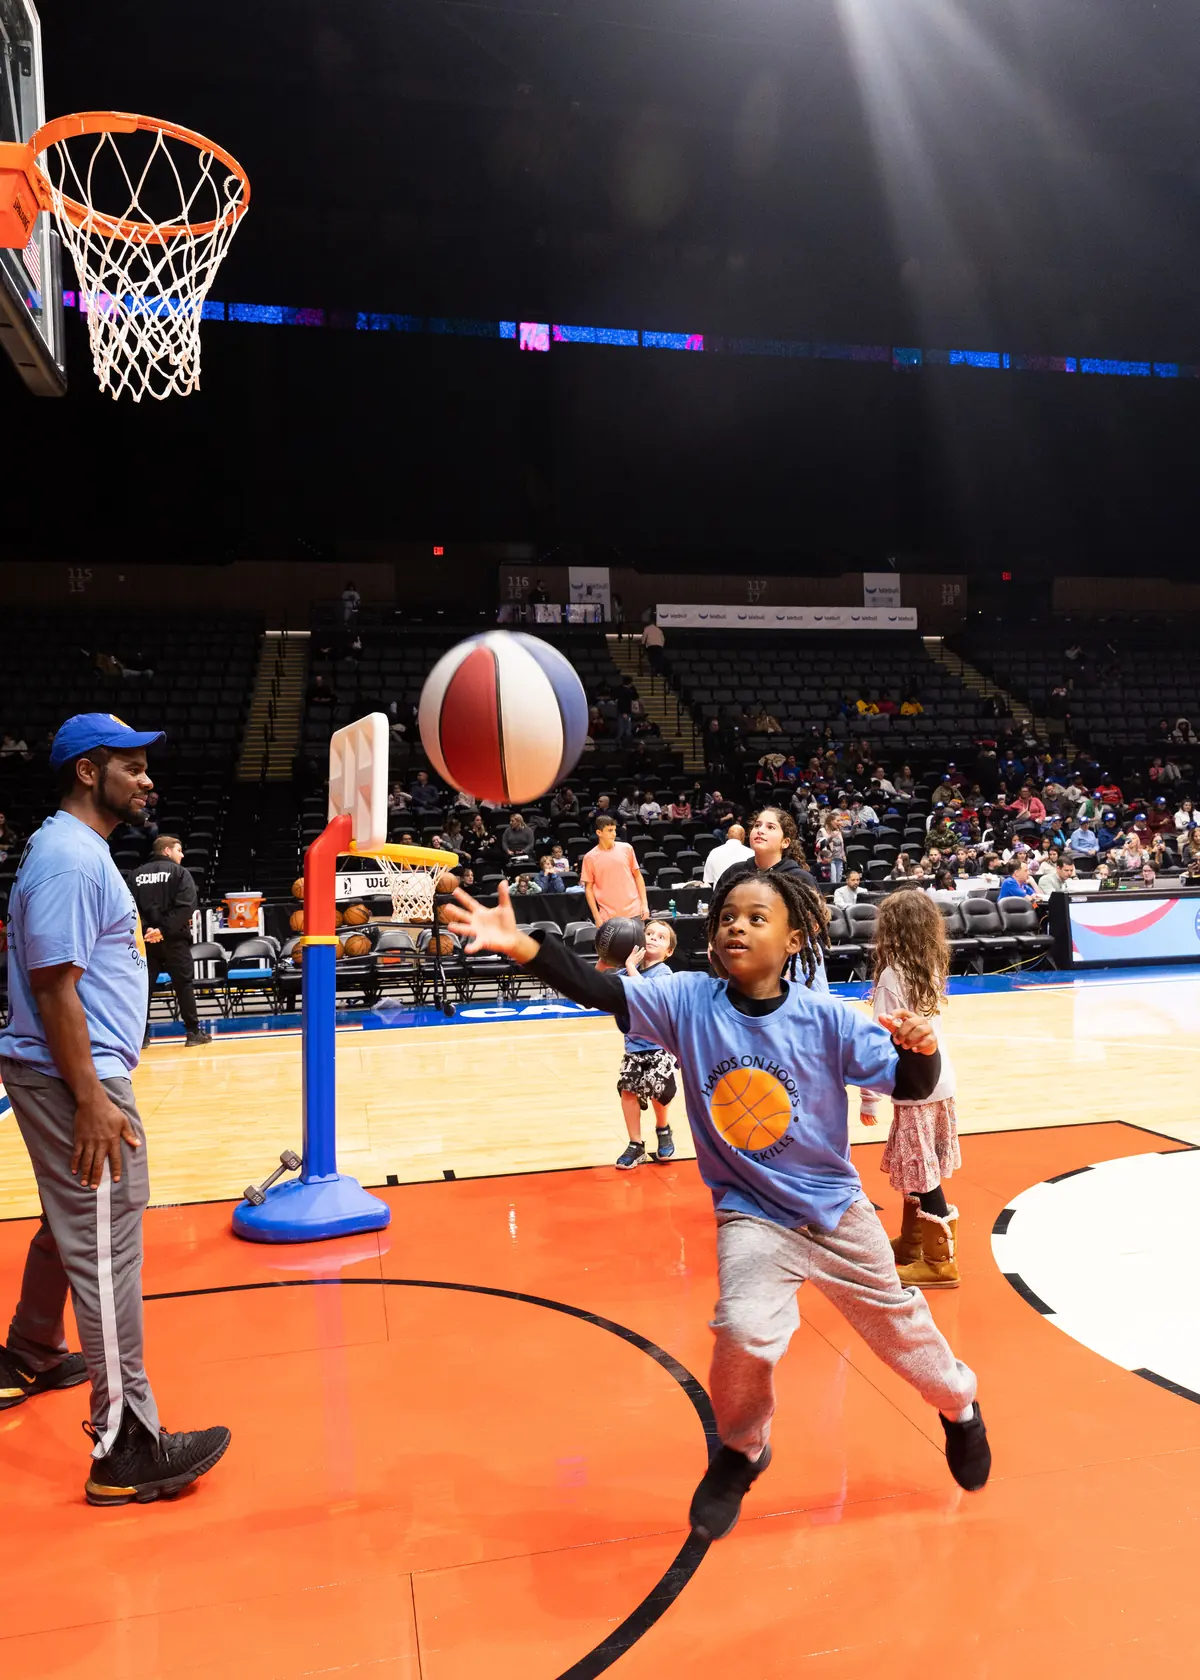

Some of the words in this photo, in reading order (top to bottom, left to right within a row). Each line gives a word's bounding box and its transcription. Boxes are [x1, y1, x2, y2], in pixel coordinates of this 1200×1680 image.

[68, 567, 93, 579] 115
[508, 576, 529, 587] 116
[747, 580, 767, 591] 117
[701, 1056, 739, 1098] HANDS
[741, 1055, 765, 1069] ON
[765, 1060, 800, 1108] HOOPS
[752, 1134, 795, 1162] SKILLS
